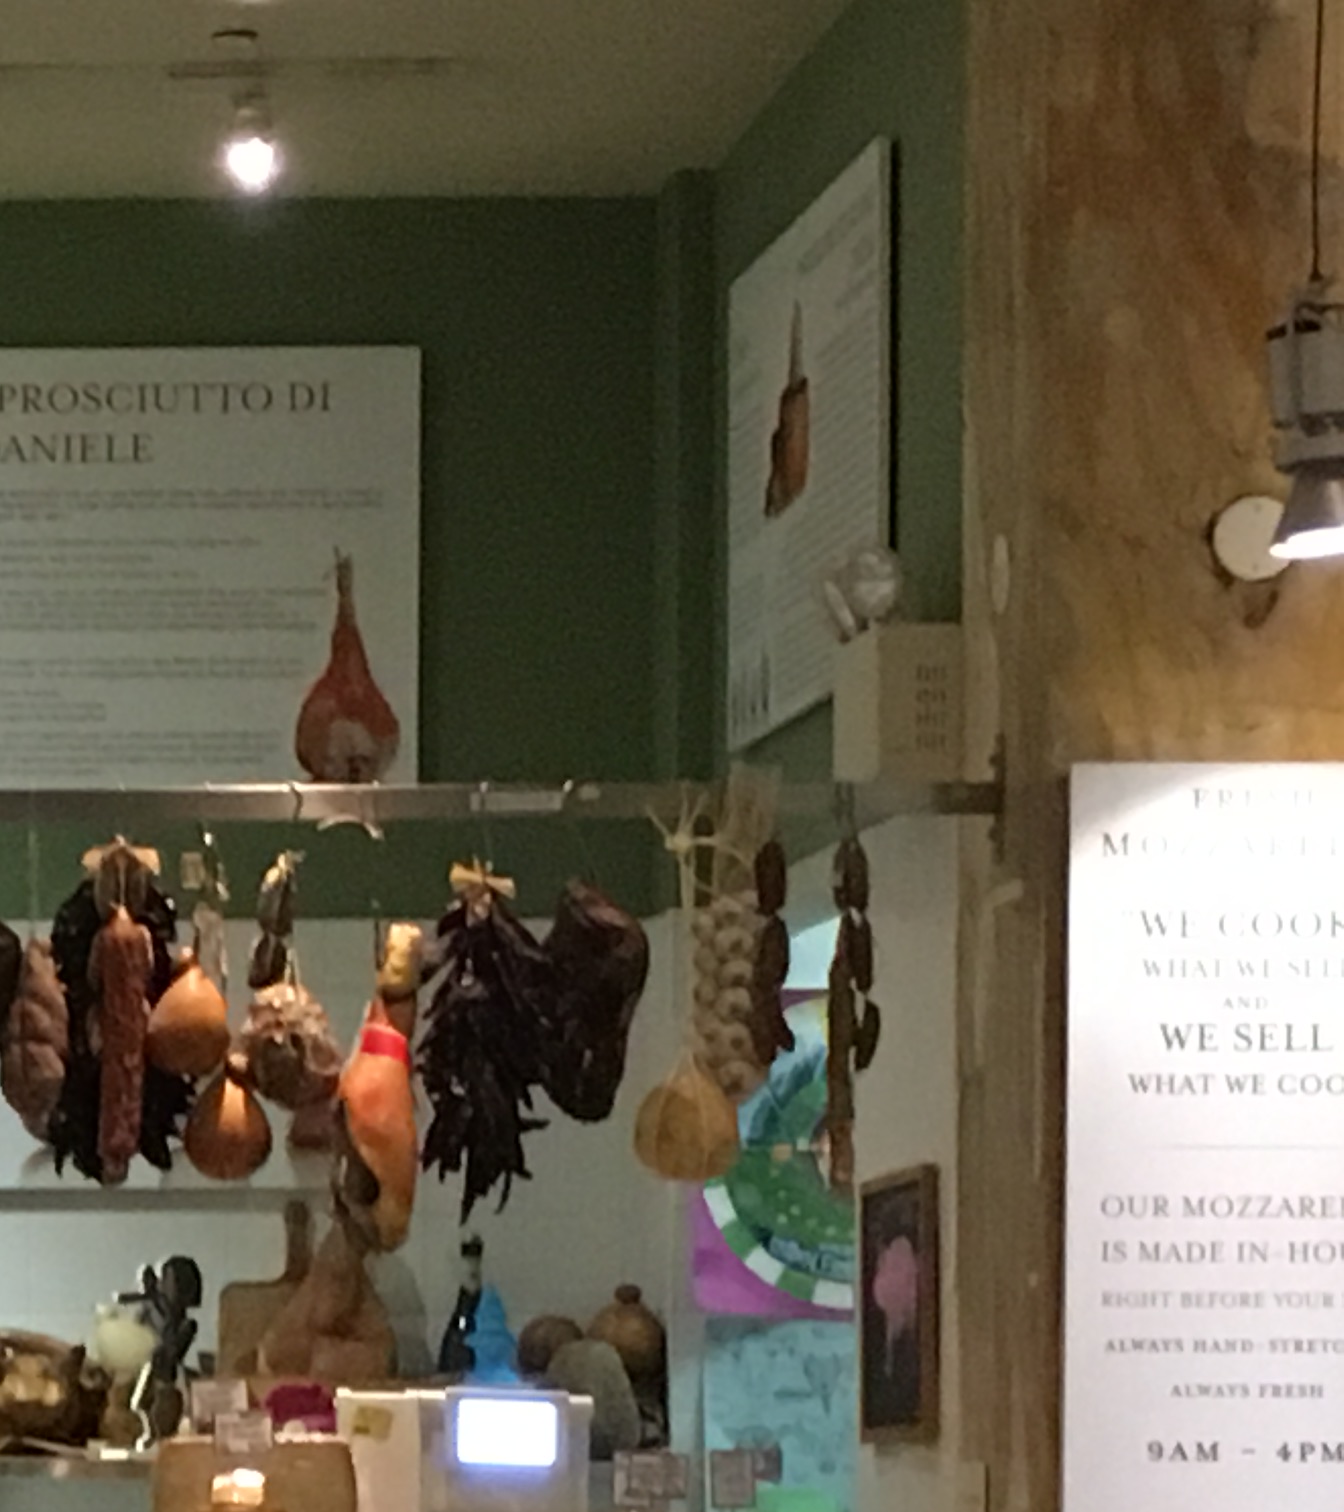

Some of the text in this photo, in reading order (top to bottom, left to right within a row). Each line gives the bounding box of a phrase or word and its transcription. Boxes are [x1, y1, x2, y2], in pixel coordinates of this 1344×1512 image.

[288, 382, 331, 413] DI
[1142, 958, 1223, 979] WHAT
[1238, 958, 1272, 979] WE
[1223, 995, 1269, 1010] AND
[1159, 1023, 1334, 1053] WE SELL
[1127, 1073, 1216, 1096] WHAT
[1225, 1073, 1267, 1096] WE
[1100, 1194, 1344, 1219] OUR MOZZARE
[1101, 1240, 1128, 1264] IS
[1138, 1240, 1224, 1264] MADE
[1101, 1290, 1335, 1310] RIGHT BEFORE YOUR
[1105, 1337, 1185, 1354] ALWAYS
[1170, 1383, 1325, 1399] ALWAYS FRESH
[1146, 1440, 1220, 1463] 9AM
[1276, 1441, 1344, 1463] 4PM
